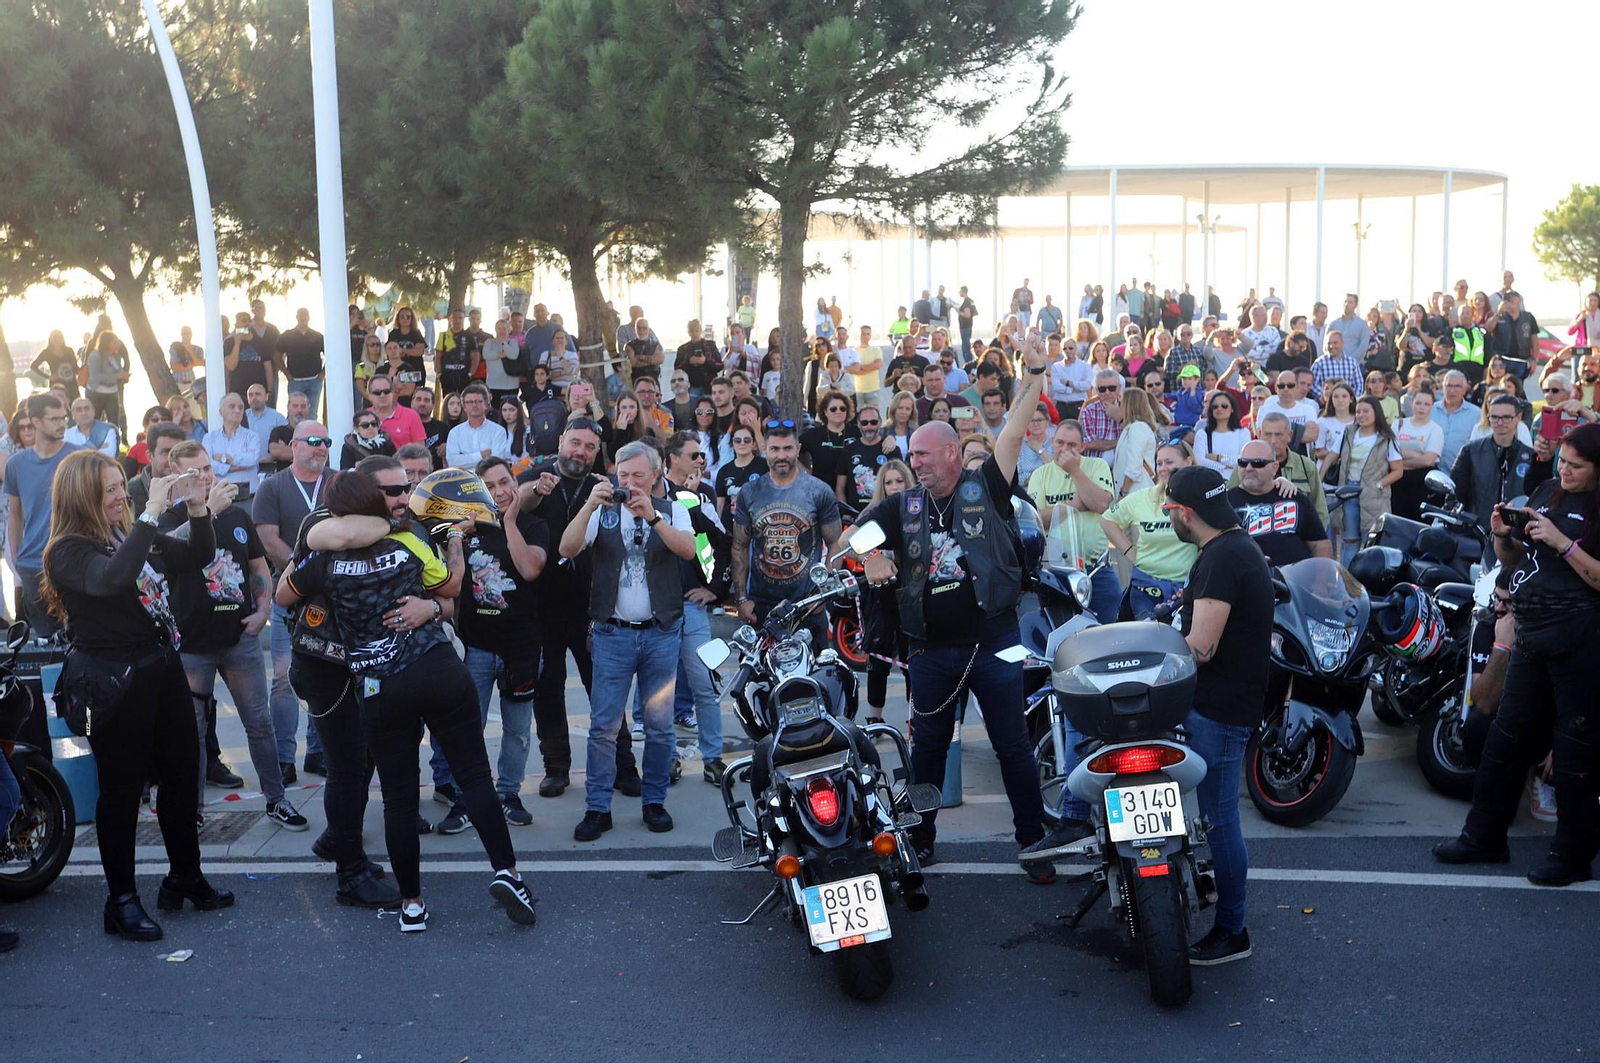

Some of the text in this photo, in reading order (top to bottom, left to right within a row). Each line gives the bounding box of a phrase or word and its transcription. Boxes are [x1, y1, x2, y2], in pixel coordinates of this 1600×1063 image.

[1248, 501, 1297, 536] 69
[769, 545, 793, 560] 66
[1107, 659, 1141, 670] SHAD
[1123, 787, 1177, 812] 3140
[1112, 810, 1173, 835] E GDW
[823, 880, 877, 910] 8916
[813, 907, 869, 935] E FXS
